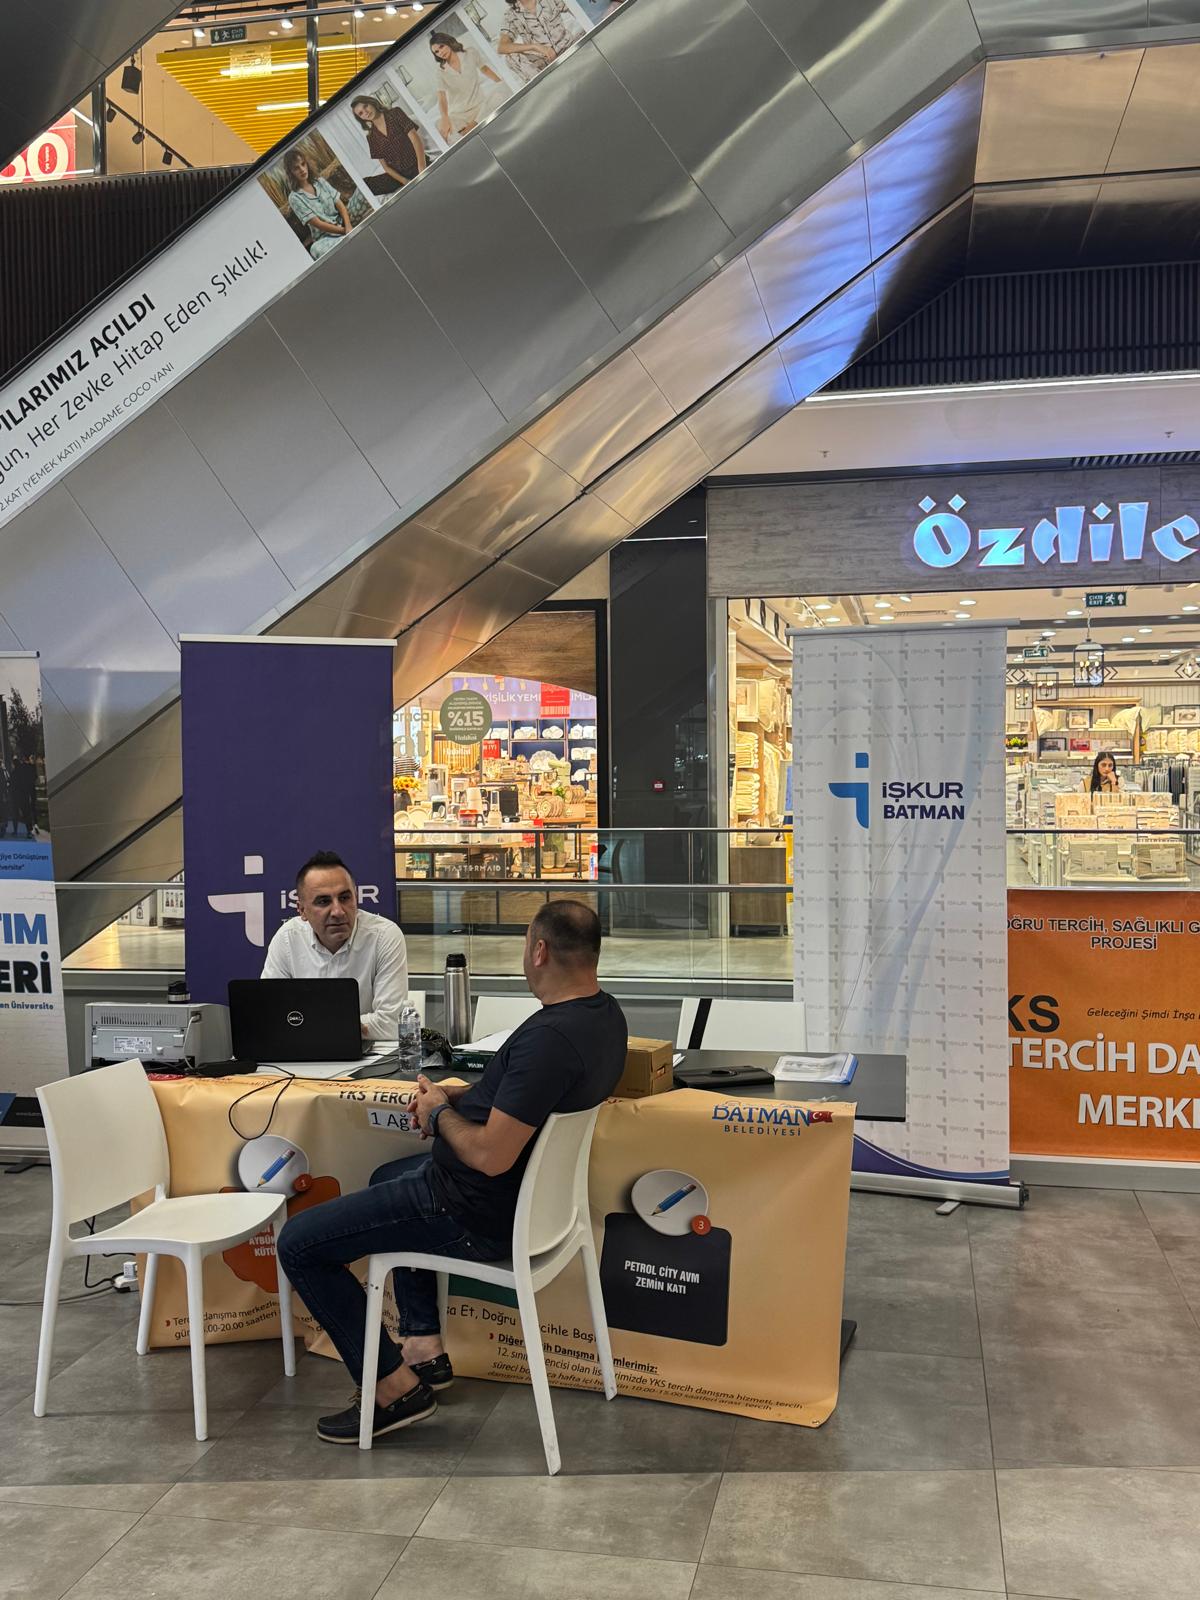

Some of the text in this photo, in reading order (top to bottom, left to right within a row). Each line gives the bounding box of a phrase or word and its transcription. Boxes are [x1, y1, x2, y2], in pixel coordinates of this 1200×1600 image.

[27, 414, 60, 447] Her
[60, 372, 114, 420] Zevke
[113, 330, 164, 376] Hitap
[163, 290, 212, 333] Eden
[211, 240, 268, 296] Şıklık!
[0, 293, 156, 431] ILARIMIZ AÇILDI
[23, 459, 59, 492] (YEMEK
[57, 439, 82, 463] KATI)
[80, 405, 124, 443] MADAME
[123, 381, 151, 407] COCO
[150, 362, 175, 384] YANI
[913, 494, 1200, 568] Özdile
[448, 711, 484, 727] %15
[883, 804, 965, 820] BATMAN
[0, 912, 48, 946] IM
[1007, 915, 1043, 931] ĞRU
[1048, 917, 1107, 932] TERCİH,
[1112, 917, 1184, 933] SAĞLIKLI
[1091, 934, 1157, 950] PROJESİ
[1087, 1007, 1138, 1020] Geleceğini
[1141, 1009, 1170, 1020] Şimdi
[1008, 1032, 1200, 1076] TERCİH DA
[371, 1111, 421, 1132] 1 Ağ
[712, 1104, 811, 1127] BATMAN
[724, 1124, 801, 1136] BELEDİYESİ
[698, 1220, 704, 1230] 3
[624, 1260, 657, 1276] PETROL
[679, 1270, 700, 1284] AVM
[635, 1276, 687, 1295] ZEMİN KATI
[461, 1304, 478, 1319] Et,
[482, 1307, 516, 1326] Doğru
[498, 1333, 524, 1347] Diğer
[554, 1344, 595, 1360] Danışma
[511, 1351, 528, 1362] sını
[571, 1363, 591, 1375] olan
[649, 1378, 666, 1388] YKS
[667, 1382, 694, 1393] tercih
[558, 1372, 581, 1382] hafta
